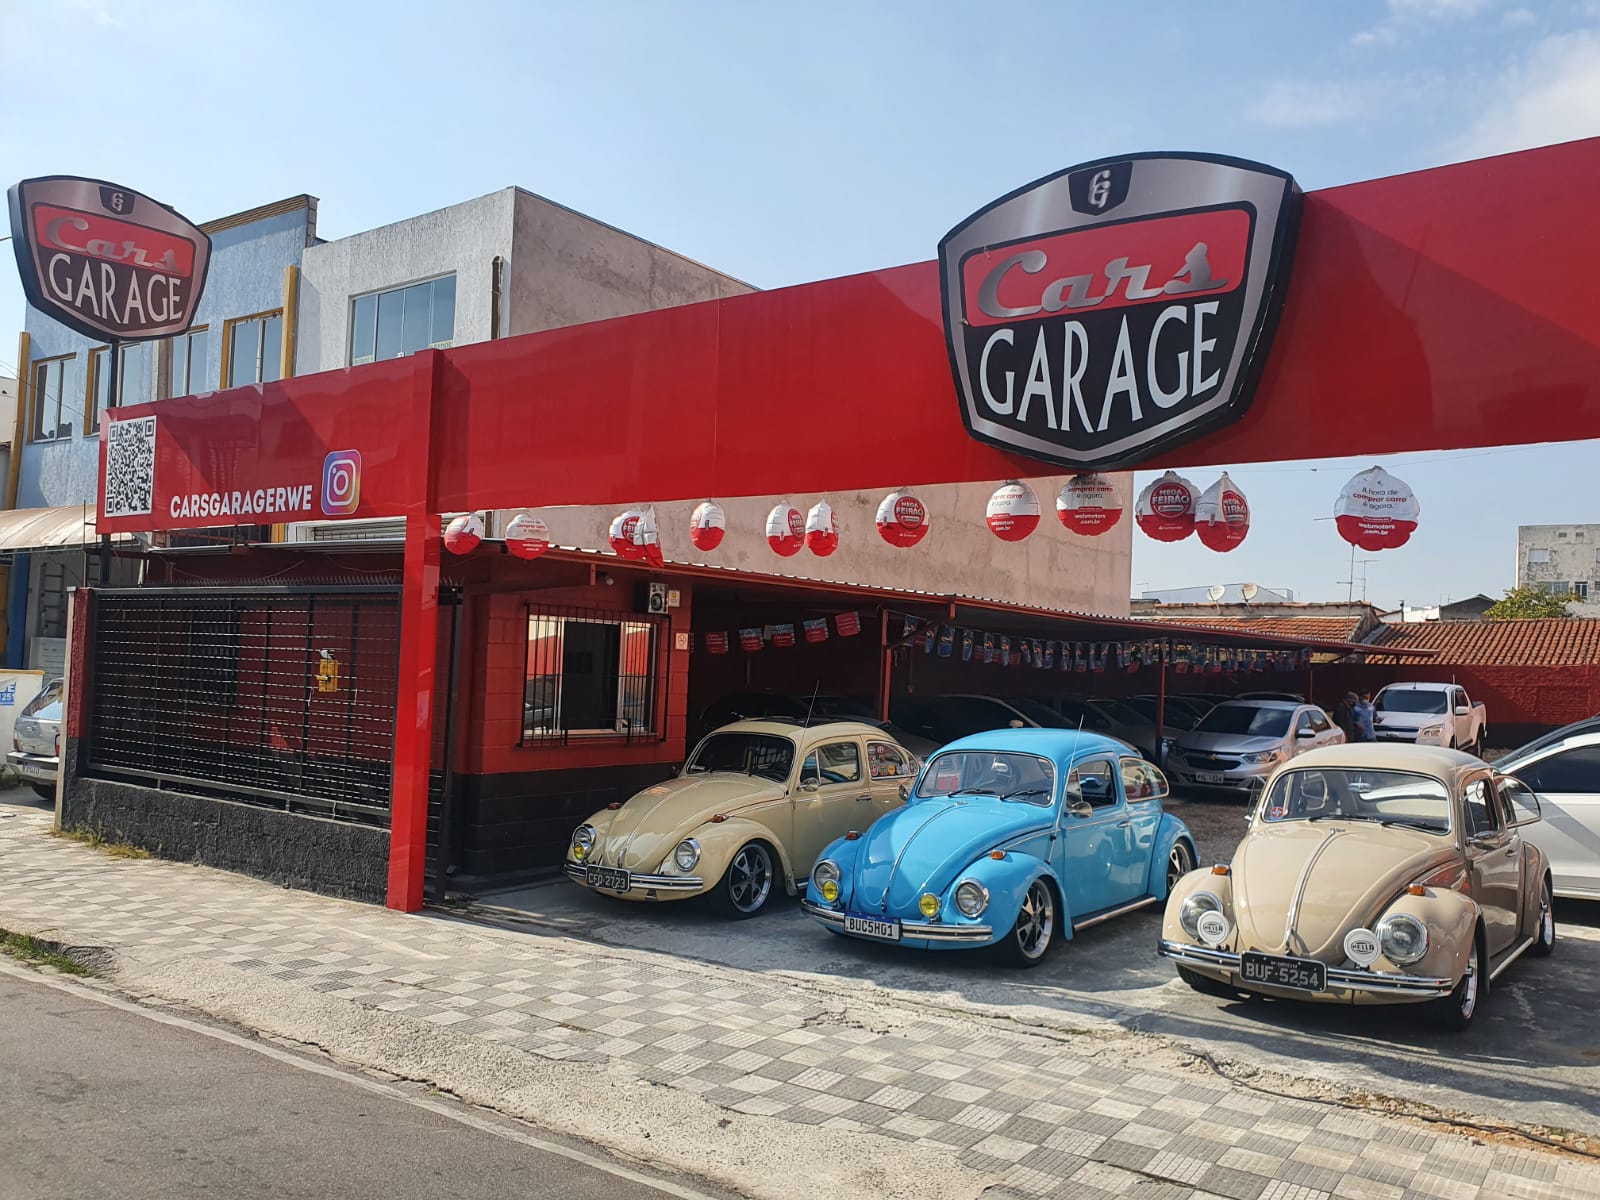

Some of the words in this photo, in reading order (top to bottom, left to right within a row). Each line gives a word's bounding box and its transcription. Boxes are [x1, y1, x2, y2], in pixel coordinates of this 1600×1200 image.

[45, 216, 186, 275] Cars
[977, 242, 1229, 318] Cars
[48, 253, 183, 324] GARAGE
[979, 301, 1221, 433] GARAGE
[170, 484, 313, 519] CARSGARAGERWE
